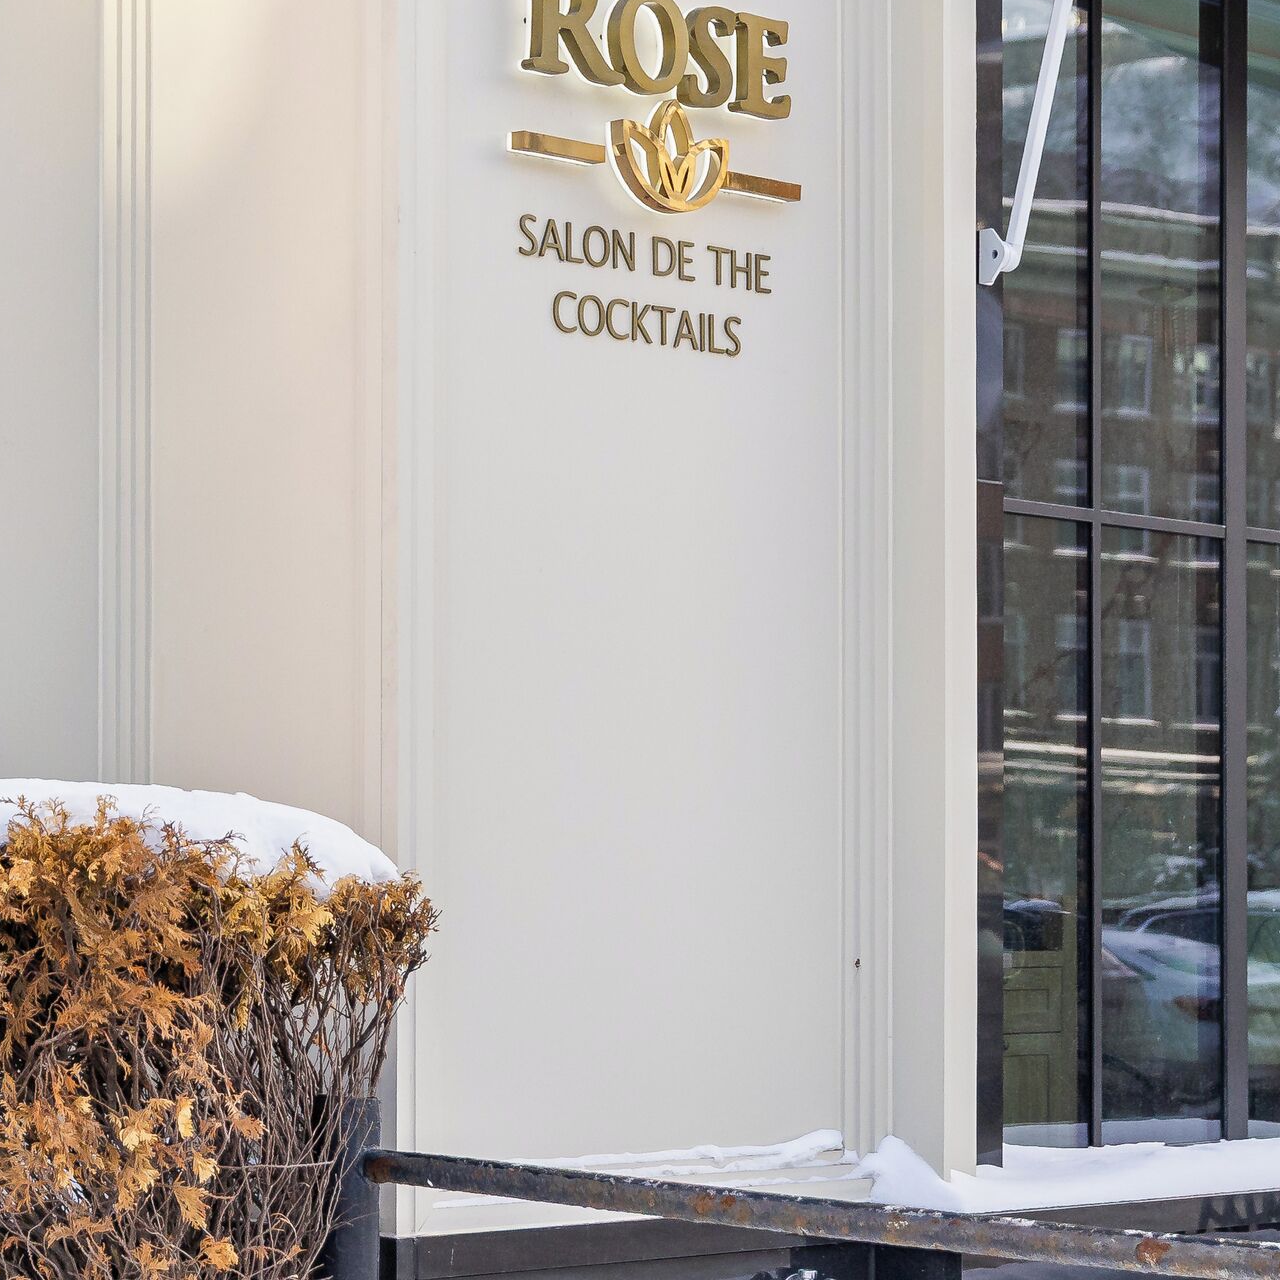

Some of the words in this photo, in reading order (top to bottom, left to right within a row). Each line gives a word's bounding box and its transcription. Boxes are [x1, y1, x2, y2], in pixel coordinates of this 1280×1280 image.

[518, 213, 636, 272] SALON
[651, 235, 696, 282] DE
[706, 244, 772, 294] THE
[552, 290, 742, 357] COCKTAILS
